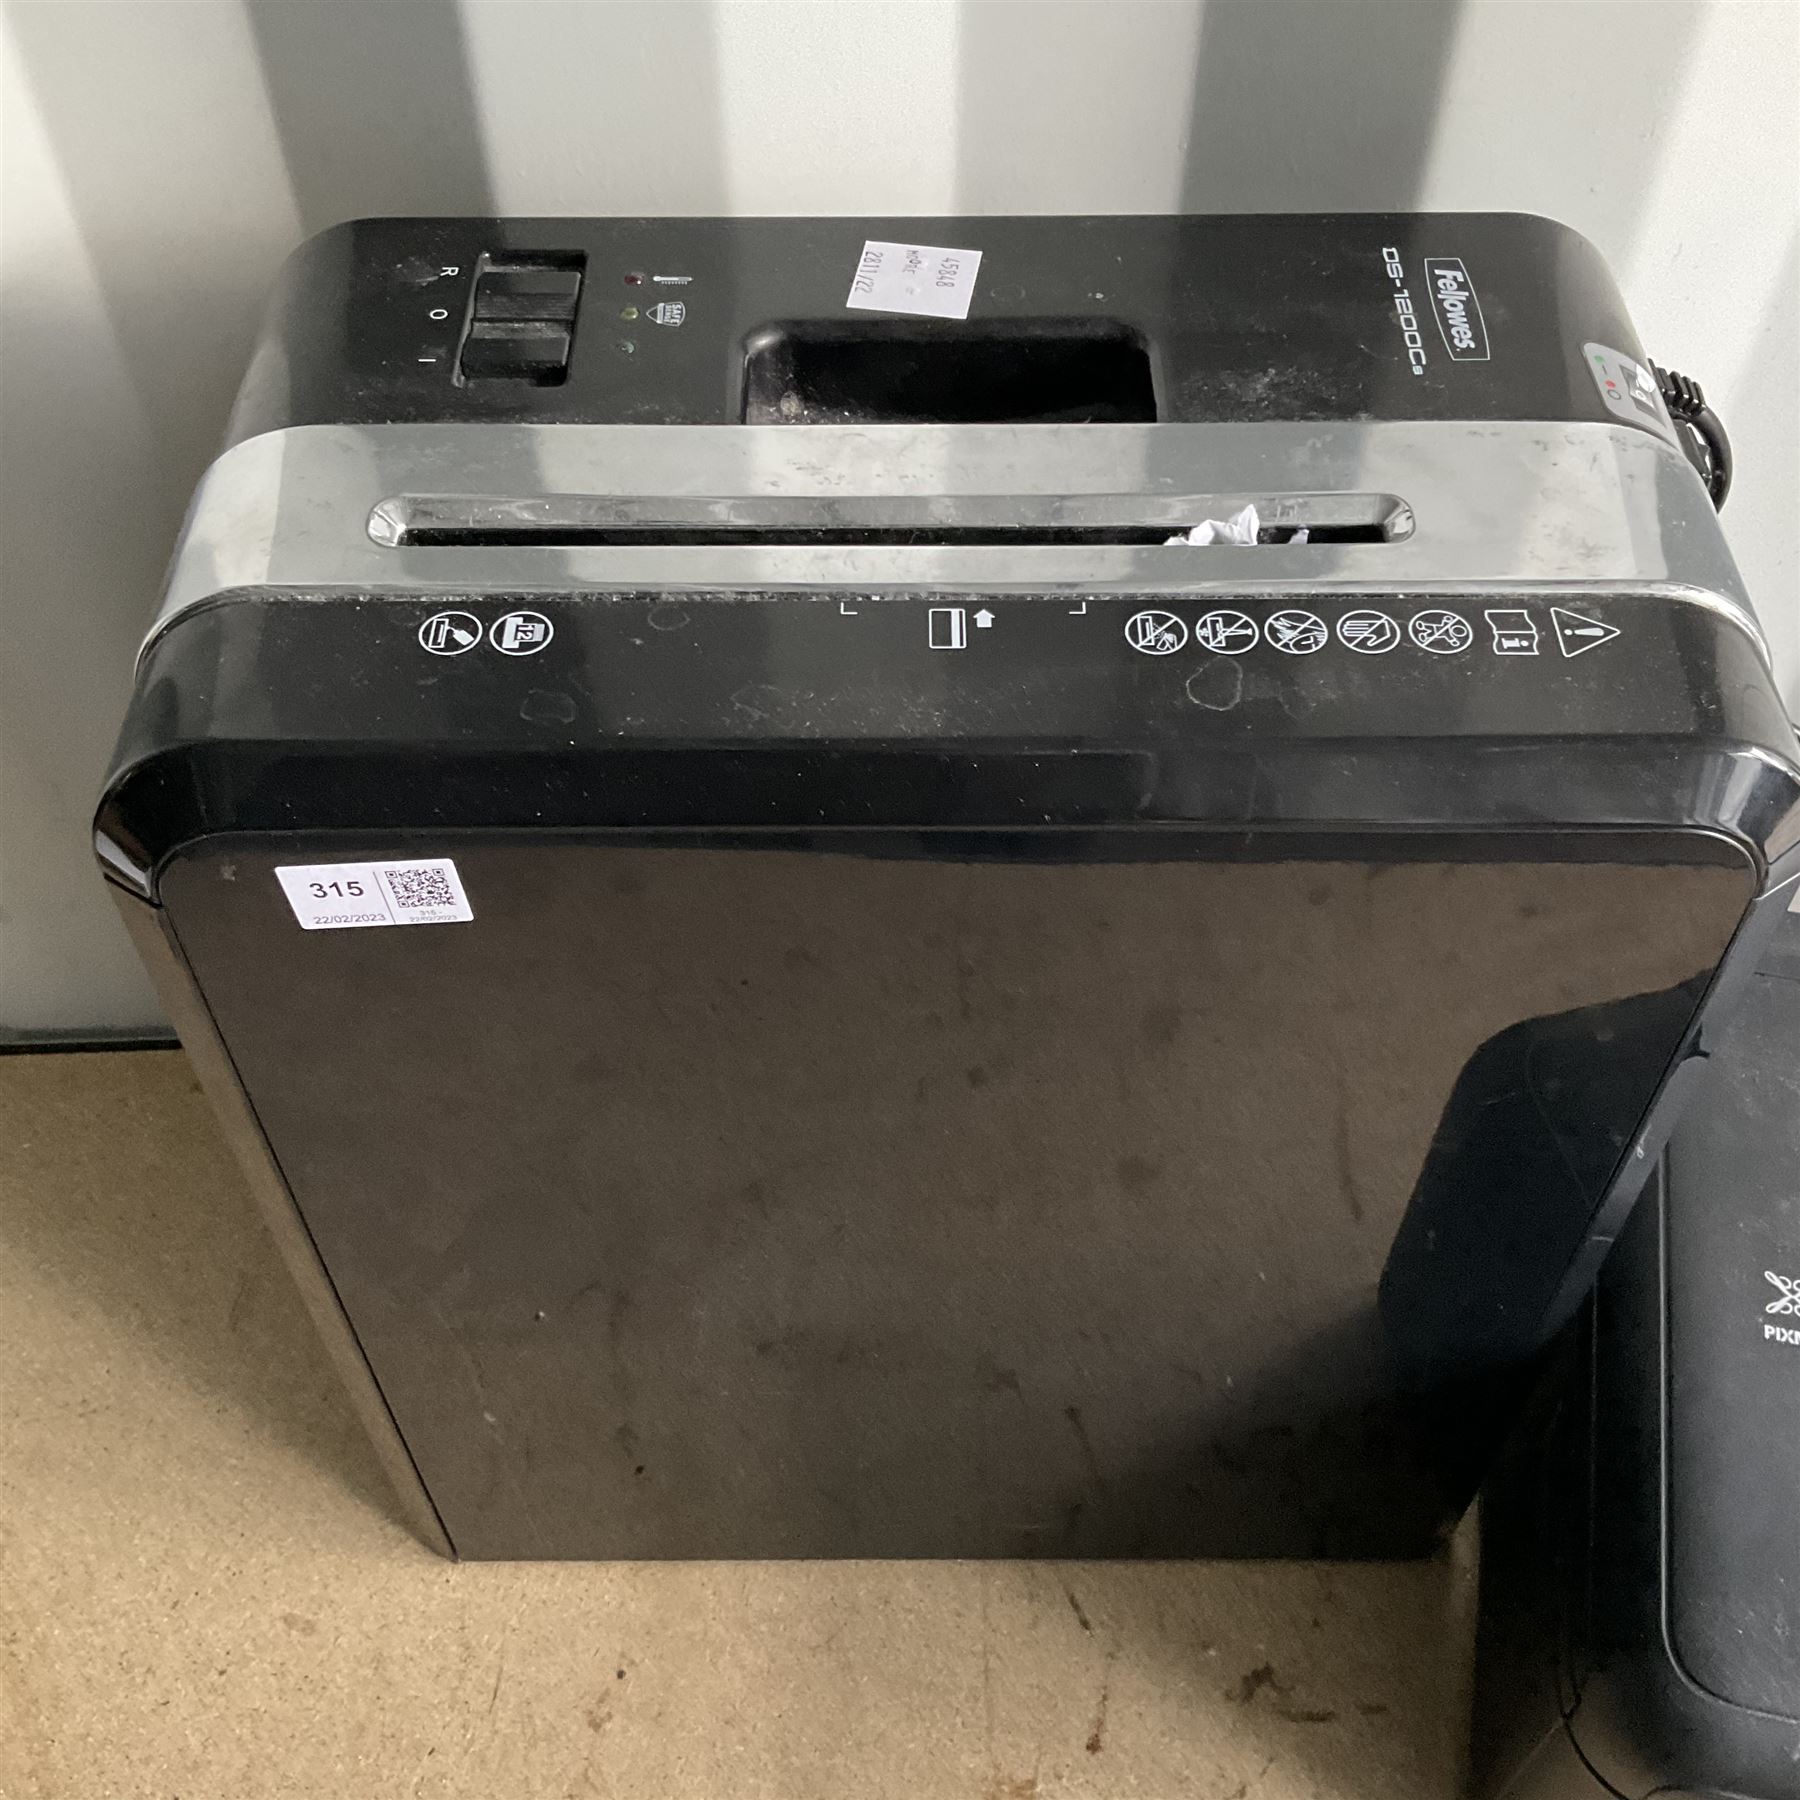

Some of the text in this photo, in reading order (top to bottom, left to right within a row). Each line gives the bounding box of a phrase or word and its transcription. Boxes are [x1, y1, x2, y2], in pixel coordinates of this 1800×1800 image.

[440, 266, 459, 277] R
[854, 250, 884, 294] 2811/22
[936, 257, 960, 288] 45848
[671, 304, 682, 323] SAFE
[1434, 268, 1476, 350] Fellowes
[516, 625, 534, 640] 12
[309, 881, 364, 899] 315
[313, 913, 386, 925] 22/02/2023
[410, 914, 458, 923] 22/02/2023
[419, 909, 435, 917] 315
